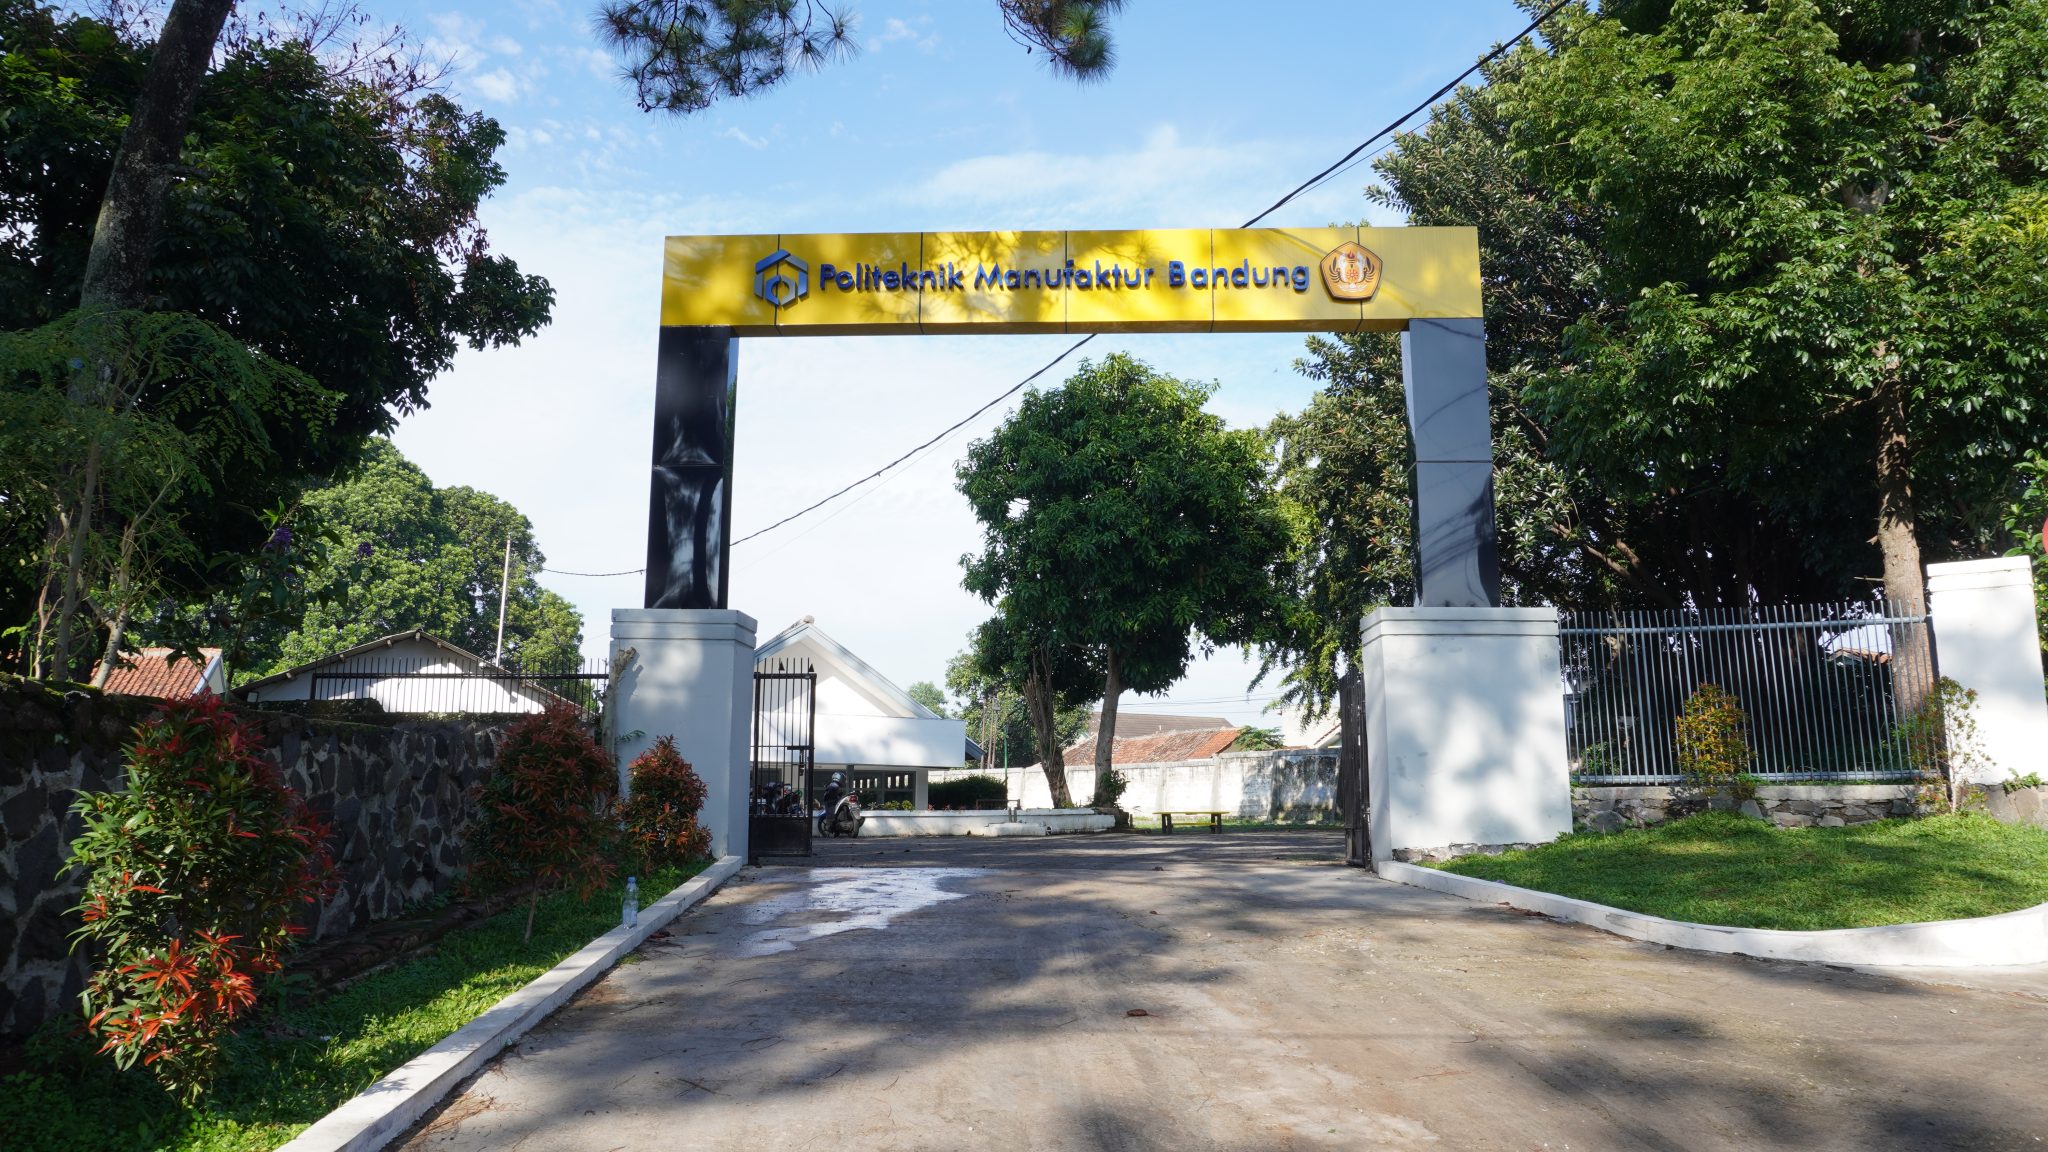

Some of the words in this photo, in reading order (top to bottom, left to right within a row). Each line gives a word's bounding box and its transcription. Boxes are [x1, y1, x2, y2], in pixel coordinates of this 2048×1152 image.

[819, 262, 964, 291] Politeknik
[974, 259, 1154, 289] Manufaktur
[1168, 258, 1310, 292] Bandung
